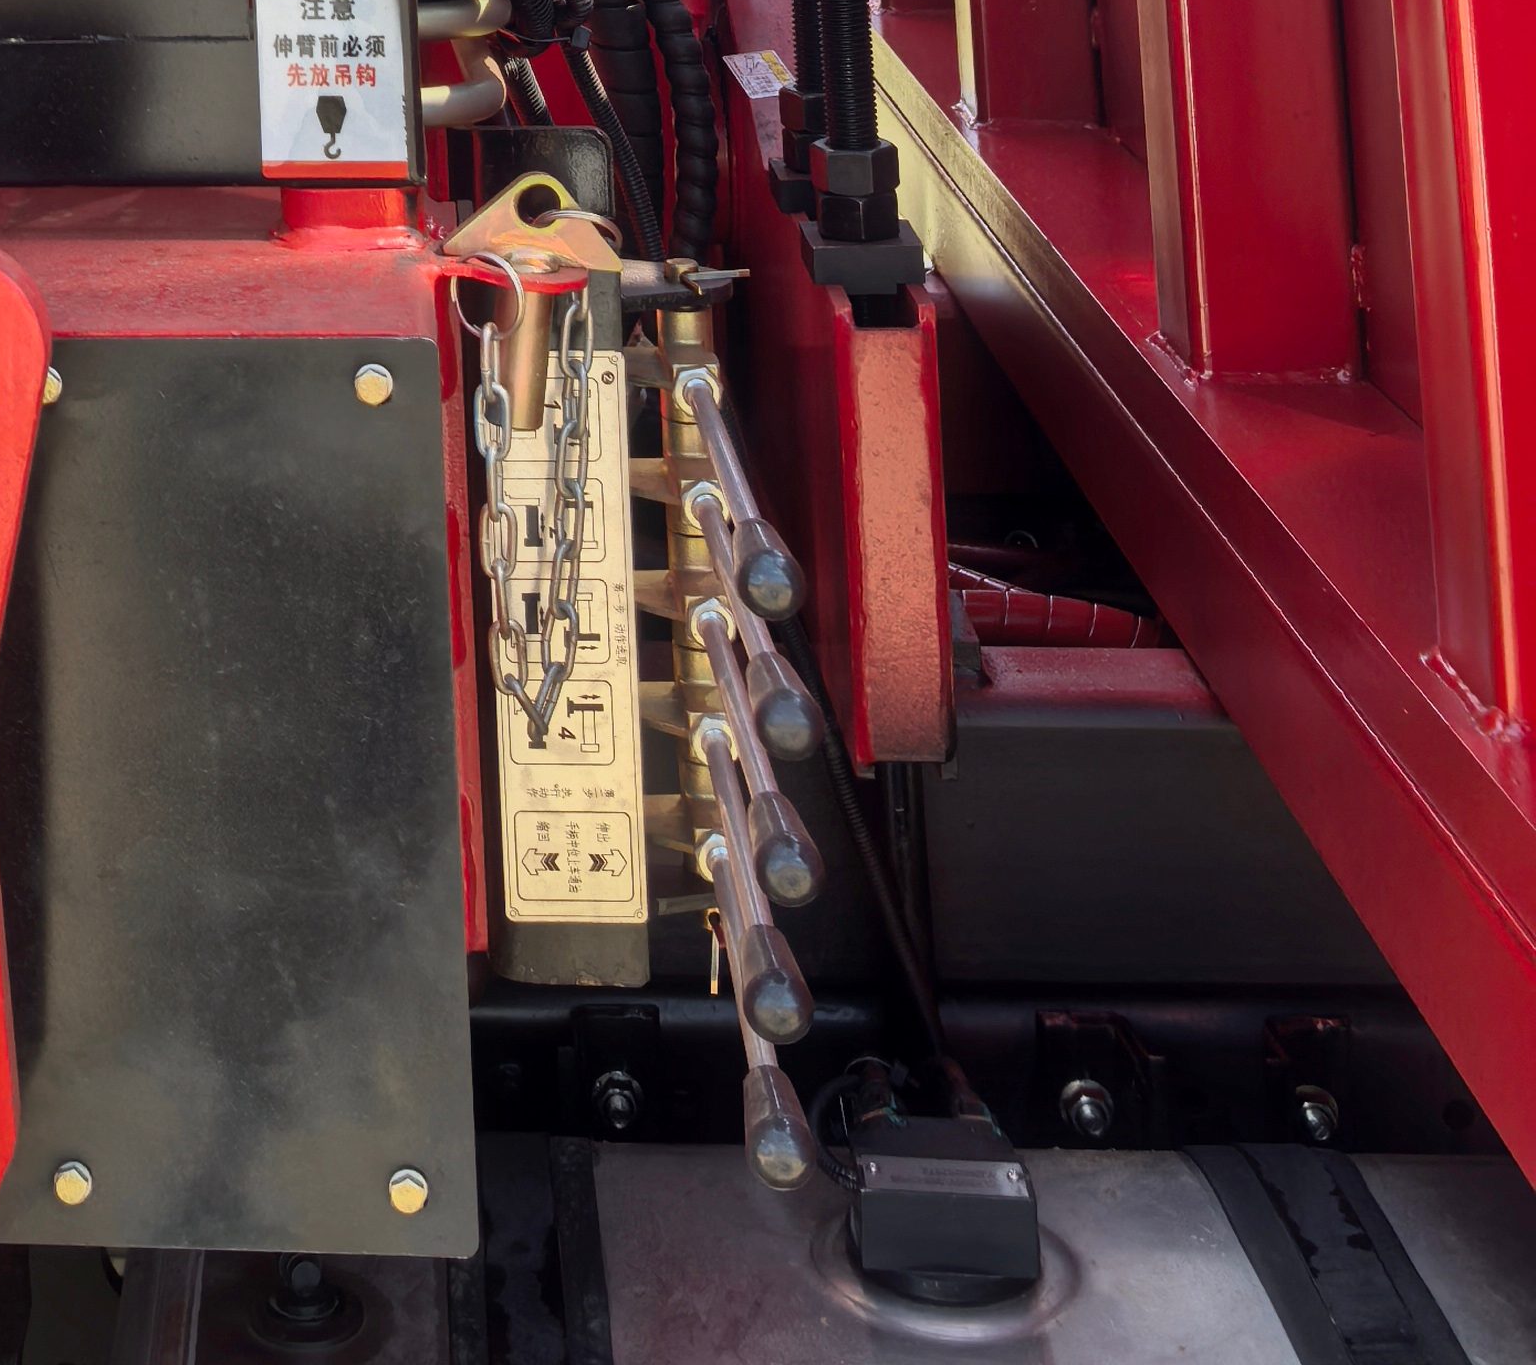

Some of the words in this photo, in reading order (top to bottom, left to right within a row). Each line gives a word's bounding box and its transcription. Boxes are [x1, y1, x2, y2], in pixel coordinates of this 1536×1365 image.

[274, 34, 385, 58] 伸臂前必须
[287, 63, 376, 87] 先放吊钩
[560, 727, 576, 740] 4
